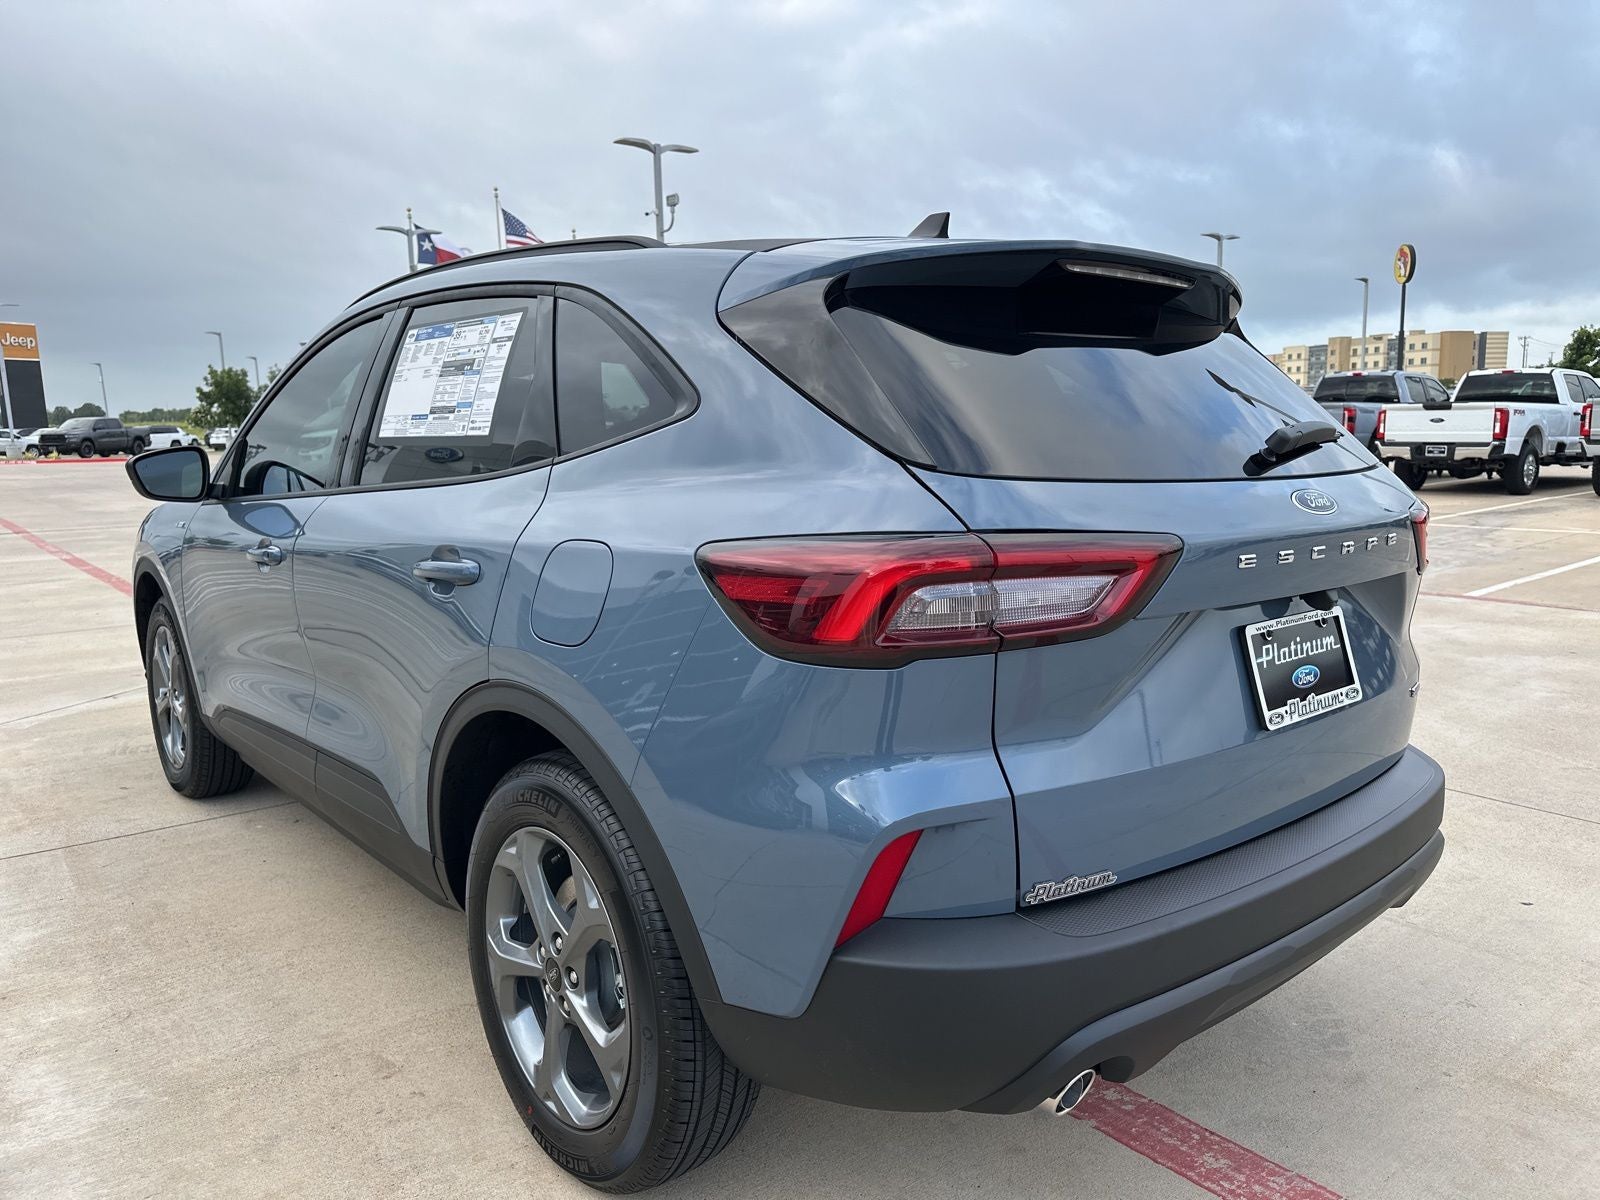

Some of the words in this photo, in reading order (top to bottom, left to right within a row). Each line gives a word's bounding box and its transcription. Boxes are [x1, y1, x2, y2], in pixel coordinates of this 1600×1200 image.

[1, 332, 36, 350] Jeep
[1305, 491, 1331, 507] Ford
[1238, 532, 1398, 569] ESCAPE
[1255, 609, 1334, 633] www.PlatinumFord.com
[1256, 635, 1341, 668] Platinum
[1297, 668, 1316, 686] Ford
[1287, 692, 1344, 721] Platinum
[504, 788, 559, 814] MICHELIN
[1025, 871, 1118, 904] Platinum
[532, 1127, 590, 1174] MICHELIN
